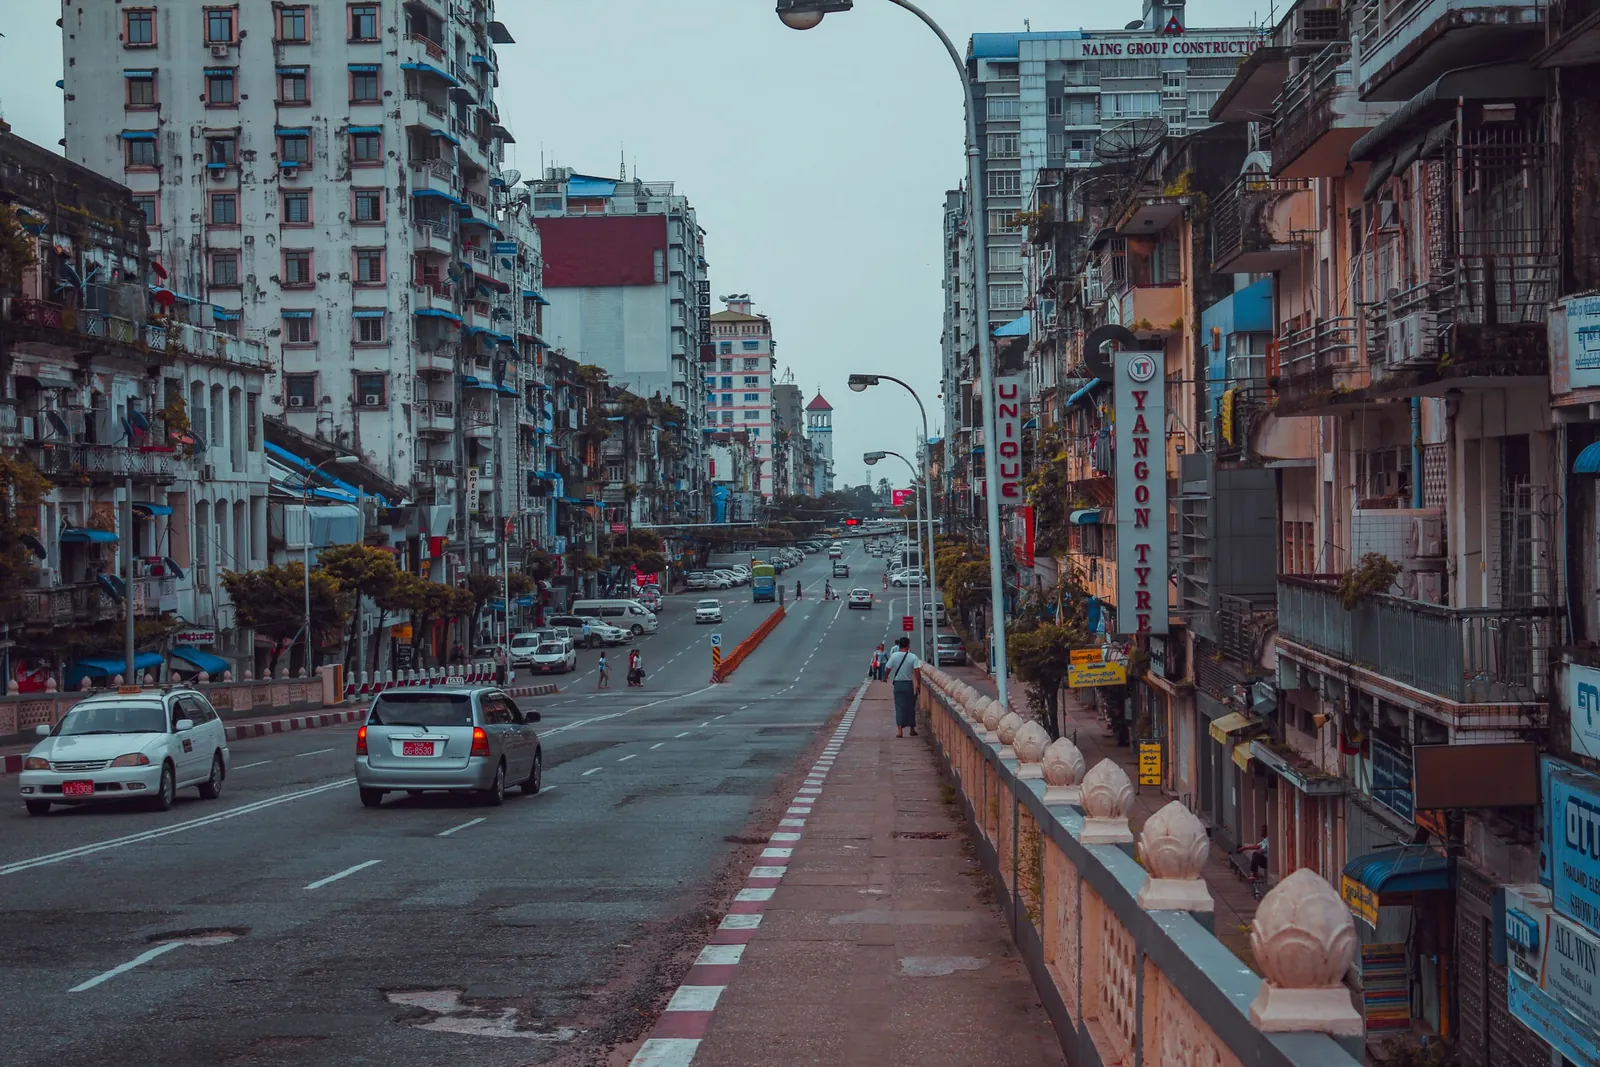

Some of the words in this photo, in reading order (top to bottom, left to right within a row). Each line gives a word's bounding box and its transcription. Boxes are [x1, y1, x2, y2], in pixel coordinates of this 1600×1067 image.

[1082, 43, 1122, 56] NAING
[1127, 42, 1168, 55] GROUP
[700, 282, 709, 343] HOTEL
[1134, 362, 1149, 374] YT
[998, 383, 1019, 497] UNIQUE
[1131, 390, 1152, 529] YANGON
[1134, 544, 1152, 633] TYRE
[403, 746, 432, 755] GG-8530
[1563, 861, 1587, 888] THAILAND
[1571, 894, 1592, 924] SHOW
[1506, 912, 1530, 948] OTTO
[1555, 924, 1574, 961] ALL
[1575, 936, 1596, 977] WIN
[1560, 963, 1576, 986] Trading
